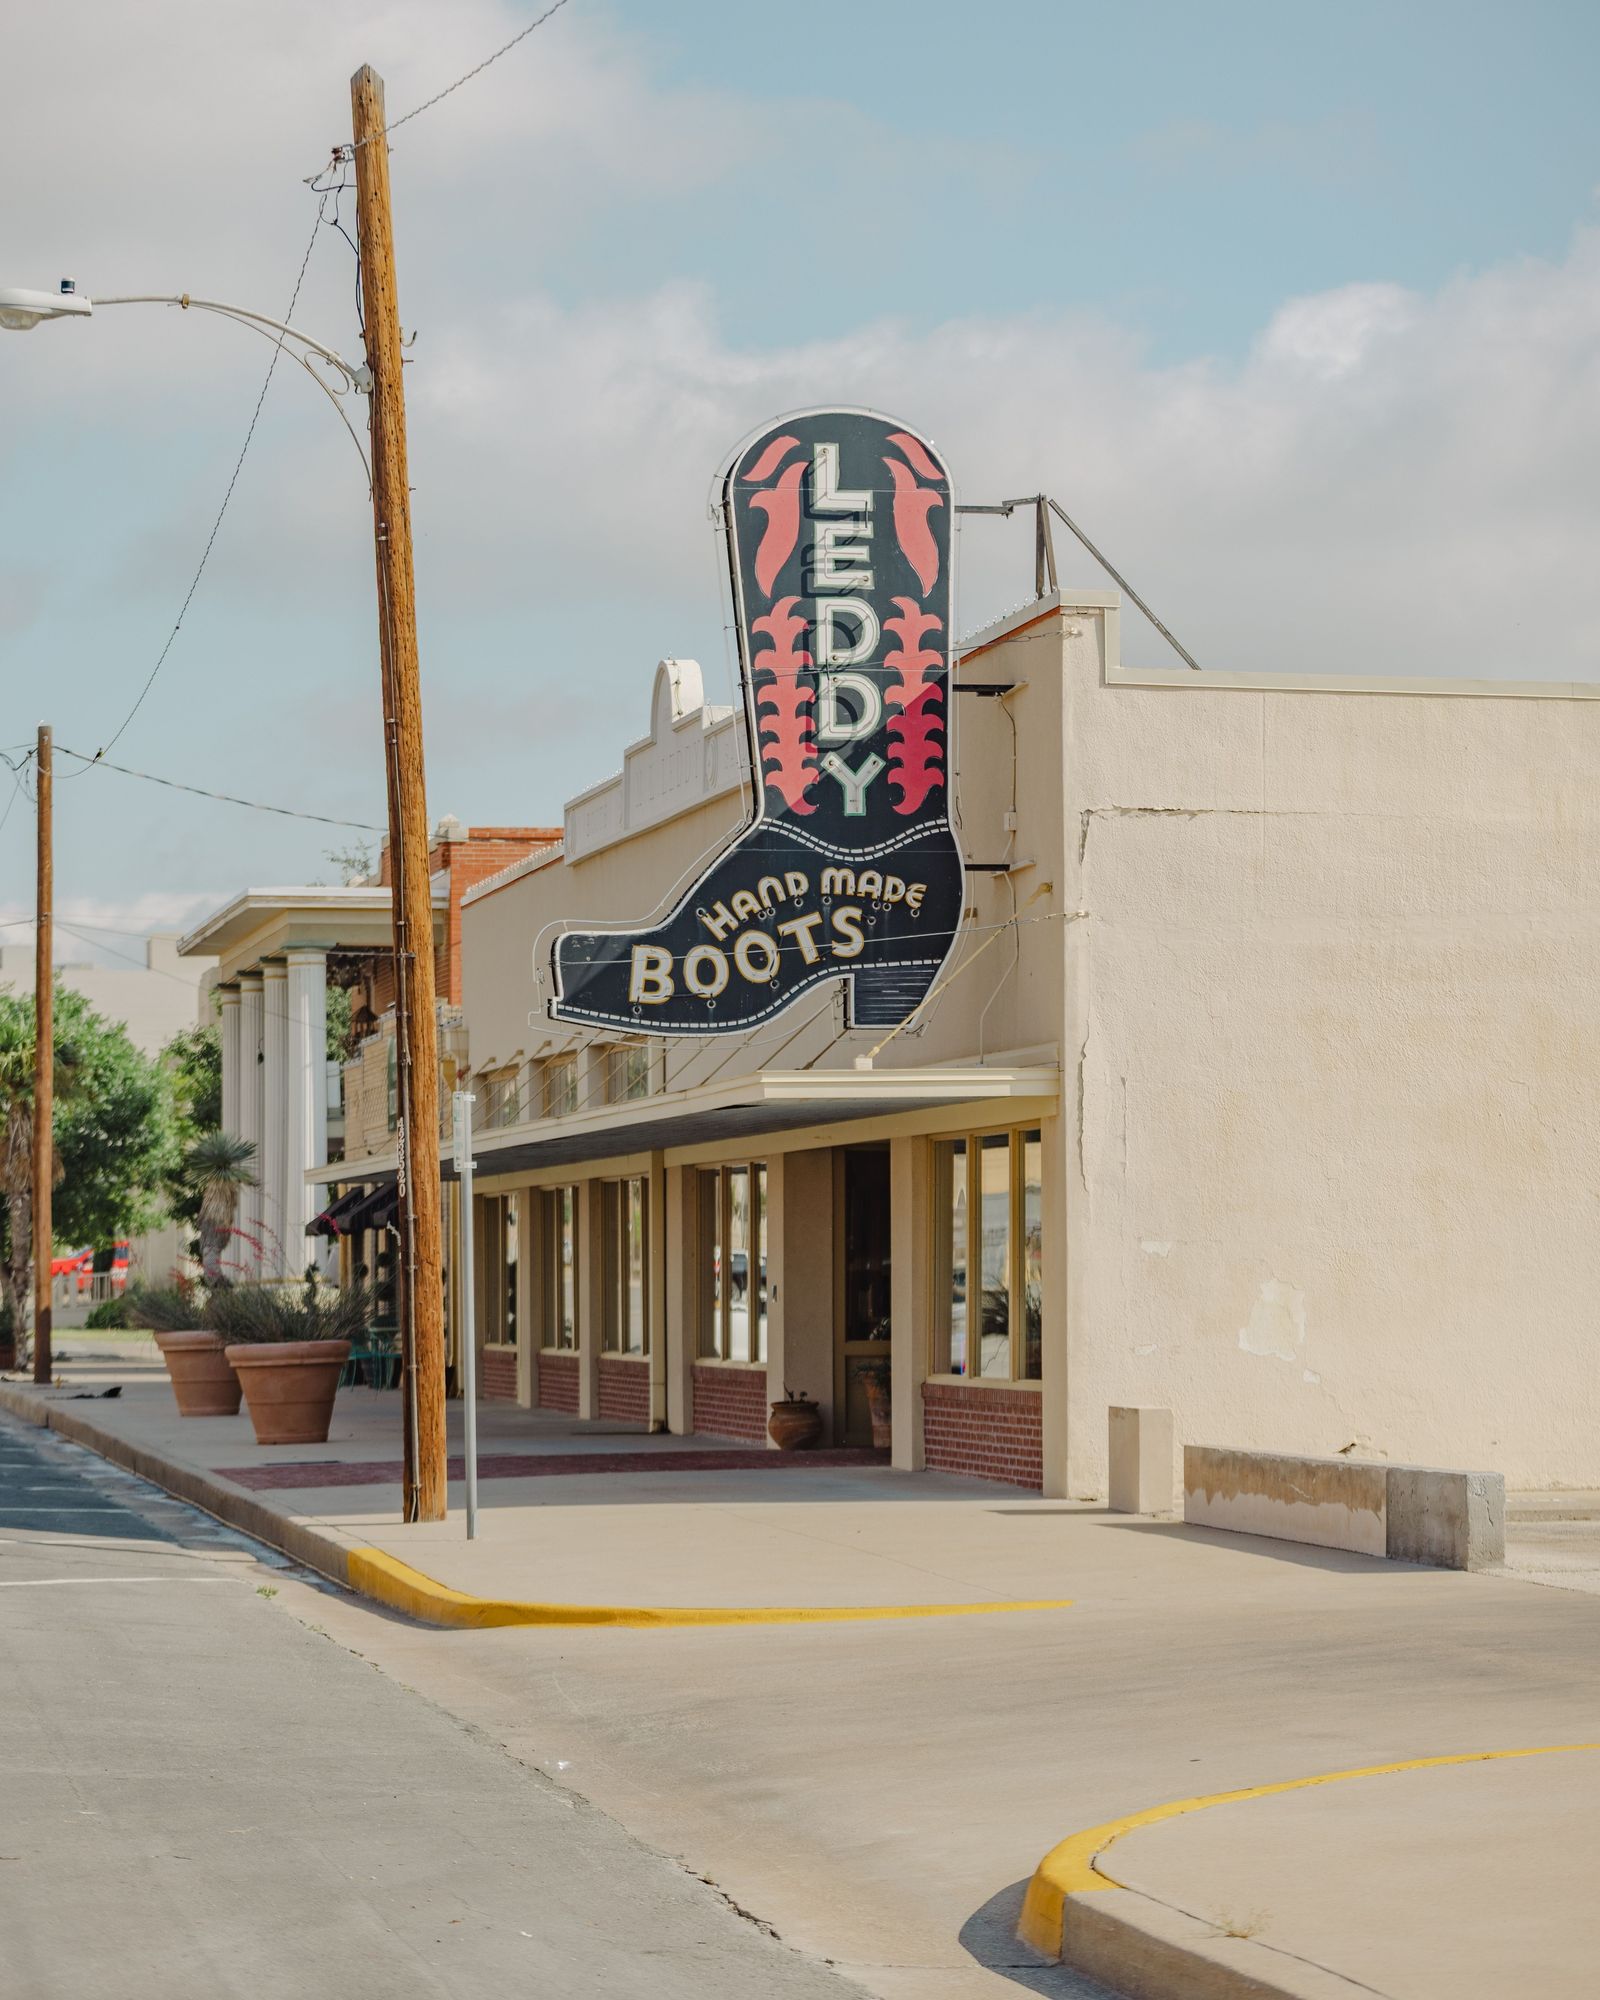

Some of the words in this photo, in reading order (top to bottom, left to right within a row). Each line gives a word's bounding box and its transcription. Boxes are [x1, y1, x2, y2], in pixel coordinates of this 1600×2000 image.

[813, 442, 887, 817] LEDDY
[701, 871, 809, 942] HAND
[820, 867, 928, 909] MADE
[629, 906, 865, 1005] BOOTS
